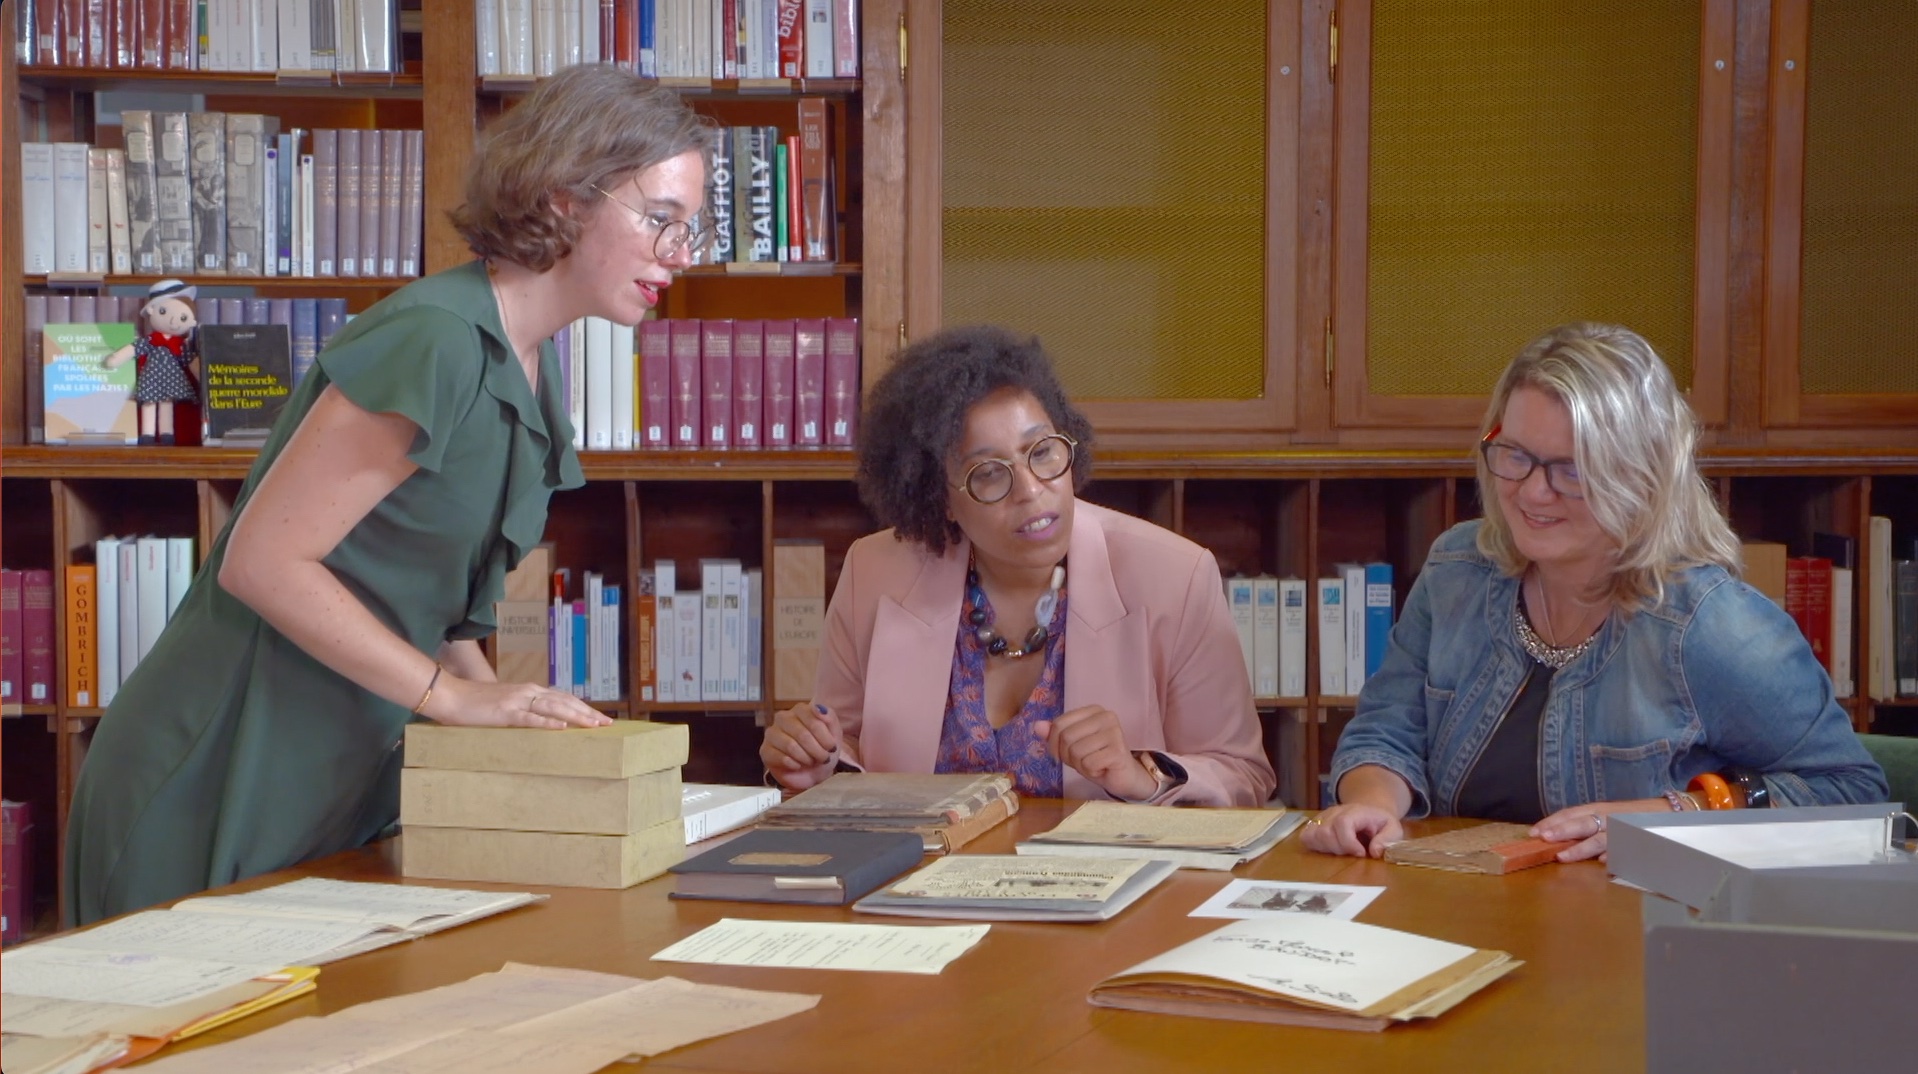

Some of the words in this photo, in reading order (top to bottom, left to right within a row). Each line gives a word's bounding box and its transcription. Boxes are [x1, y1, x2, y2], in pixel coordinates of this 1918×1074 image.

[713, 153, 731, 253] GAFFIOT
[751, 155, 772, 256] BAILLY
[58, 334, 73, 343] OÙ
[75, 335, 102, 343] SONT
[71, 345, 87, 353] LES
[208, 364, 259, 374] Mémoires
[209, 377, 222, 386] de
[223, 376, 233, 385] la
[235, 374, 277, 385] seconde
[53, 383, 72, 392] PAR
[74, 383, 90, 392] LES
[209, 389, 241, 398] guerre
[243, 385, 288, 397] mondiale
[210, 399, 234, 409] dans
[235, 398, 263, 409] l'Eure
[780, 605, 816, 615] HISTOIRE
[75, 584, 89, 691] GOMBRICH
